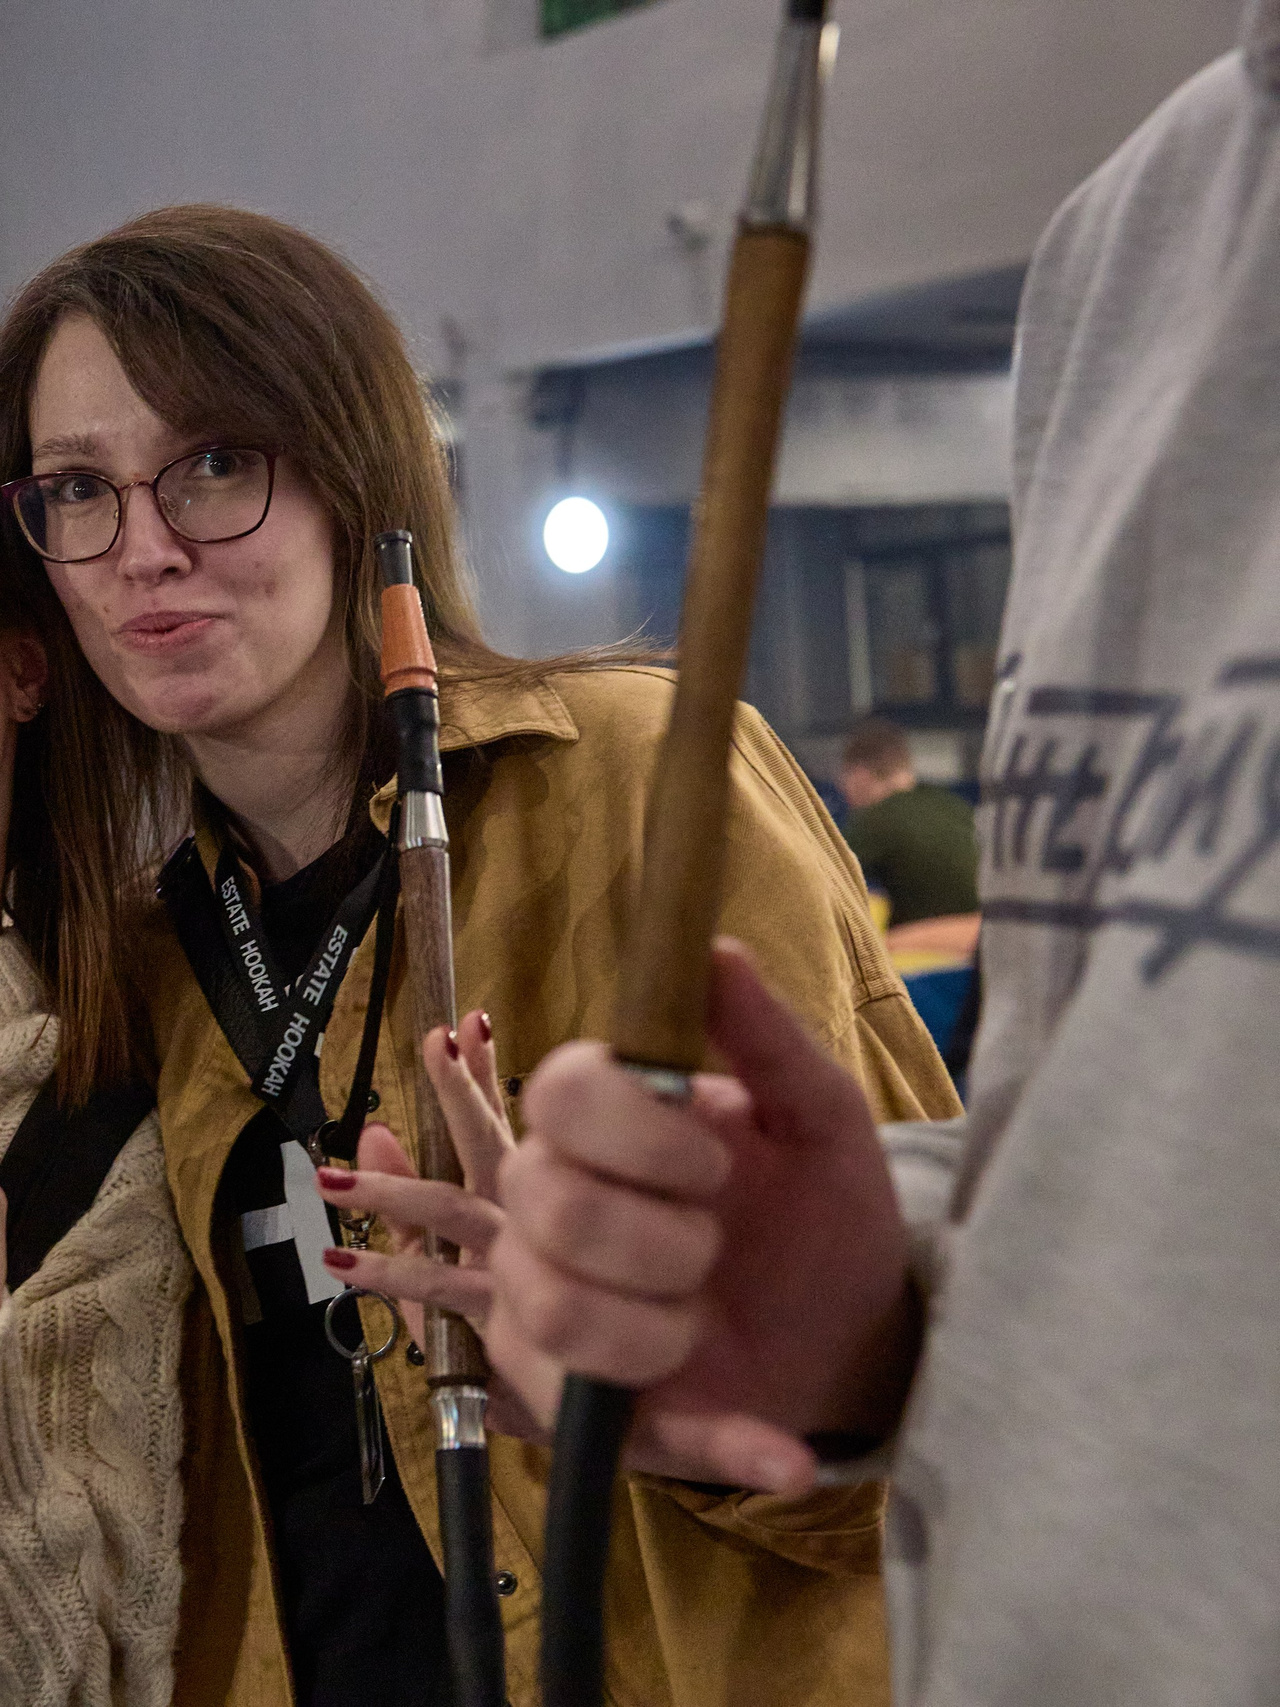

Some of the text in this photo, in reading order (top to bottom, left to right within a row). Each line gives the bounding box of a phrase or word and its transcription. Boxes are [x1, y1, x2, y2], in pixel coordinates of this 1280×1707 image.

[221, 875, 280, 1013] ESTATE HOOKAH
[260, 924, 348, 1097] ESTATE HOOKAH
